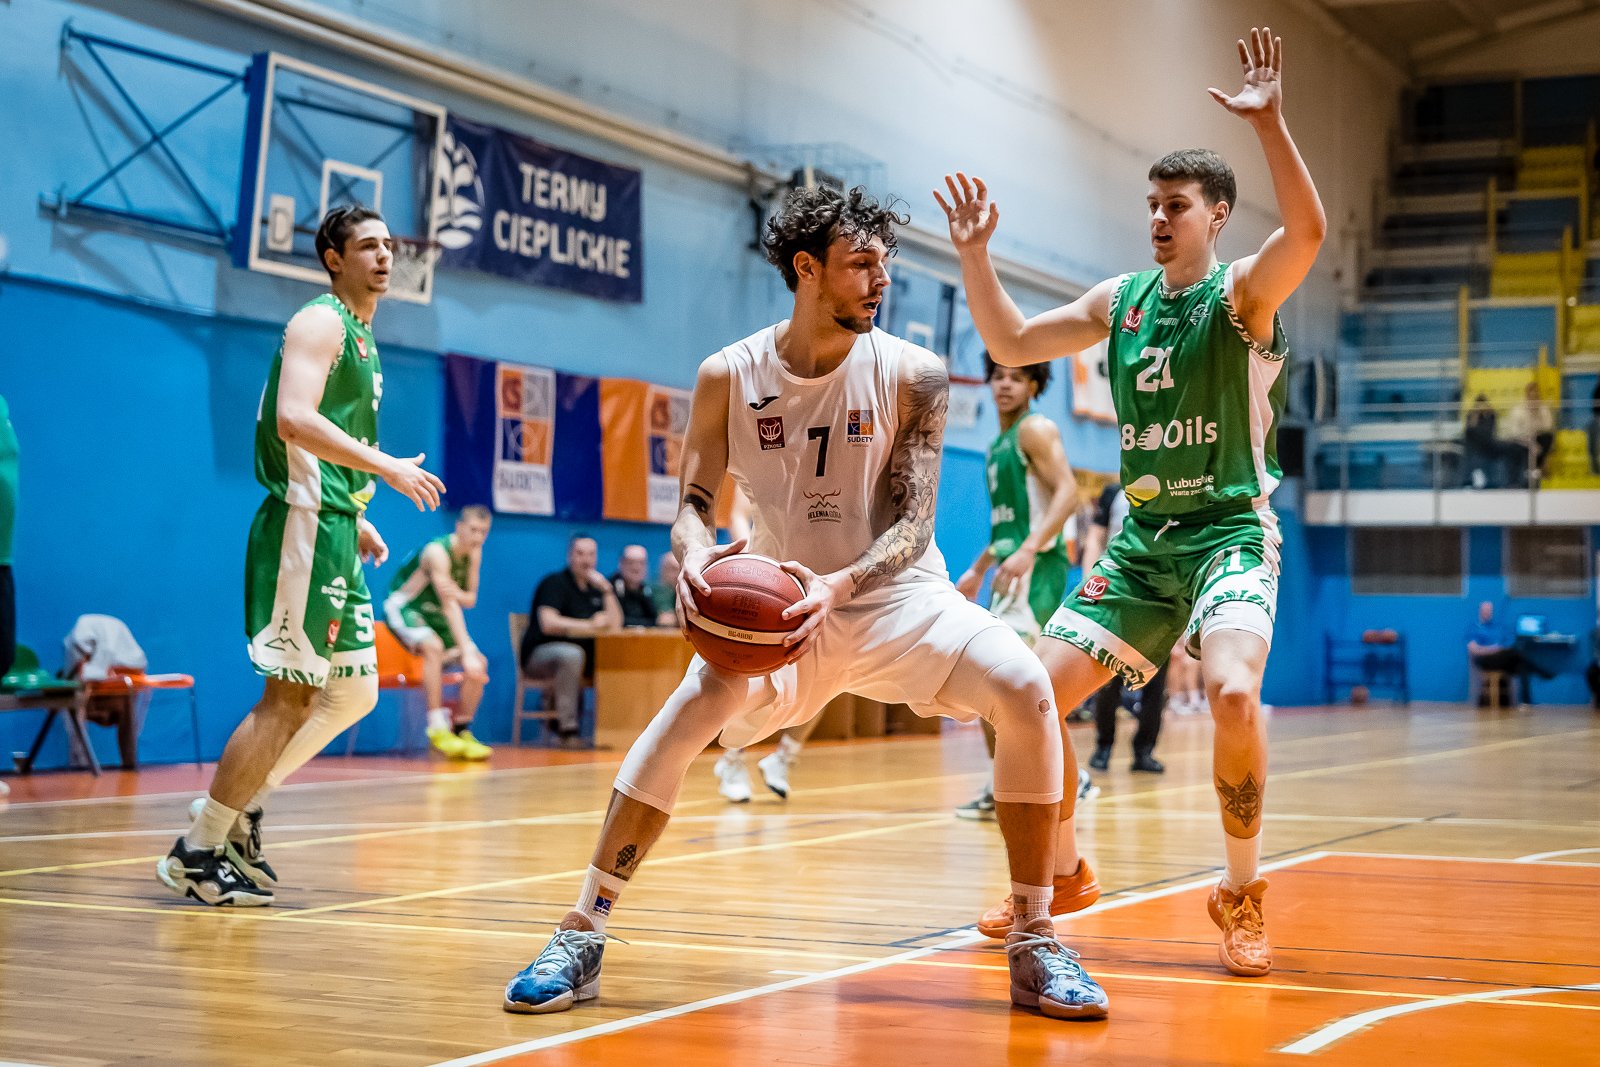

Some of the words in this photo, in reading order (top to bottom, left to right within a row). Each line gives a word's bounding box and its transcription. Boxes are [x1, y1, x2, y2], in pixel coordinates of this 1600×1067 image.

[518, 161, 607, 223] TERMY
[492, 209, 632, 280] CIEPLICKIE
[1136, 346, 1175, 392] 21
[807, 426, 830, 477] 7
[354, 603, 375, 643] 5
